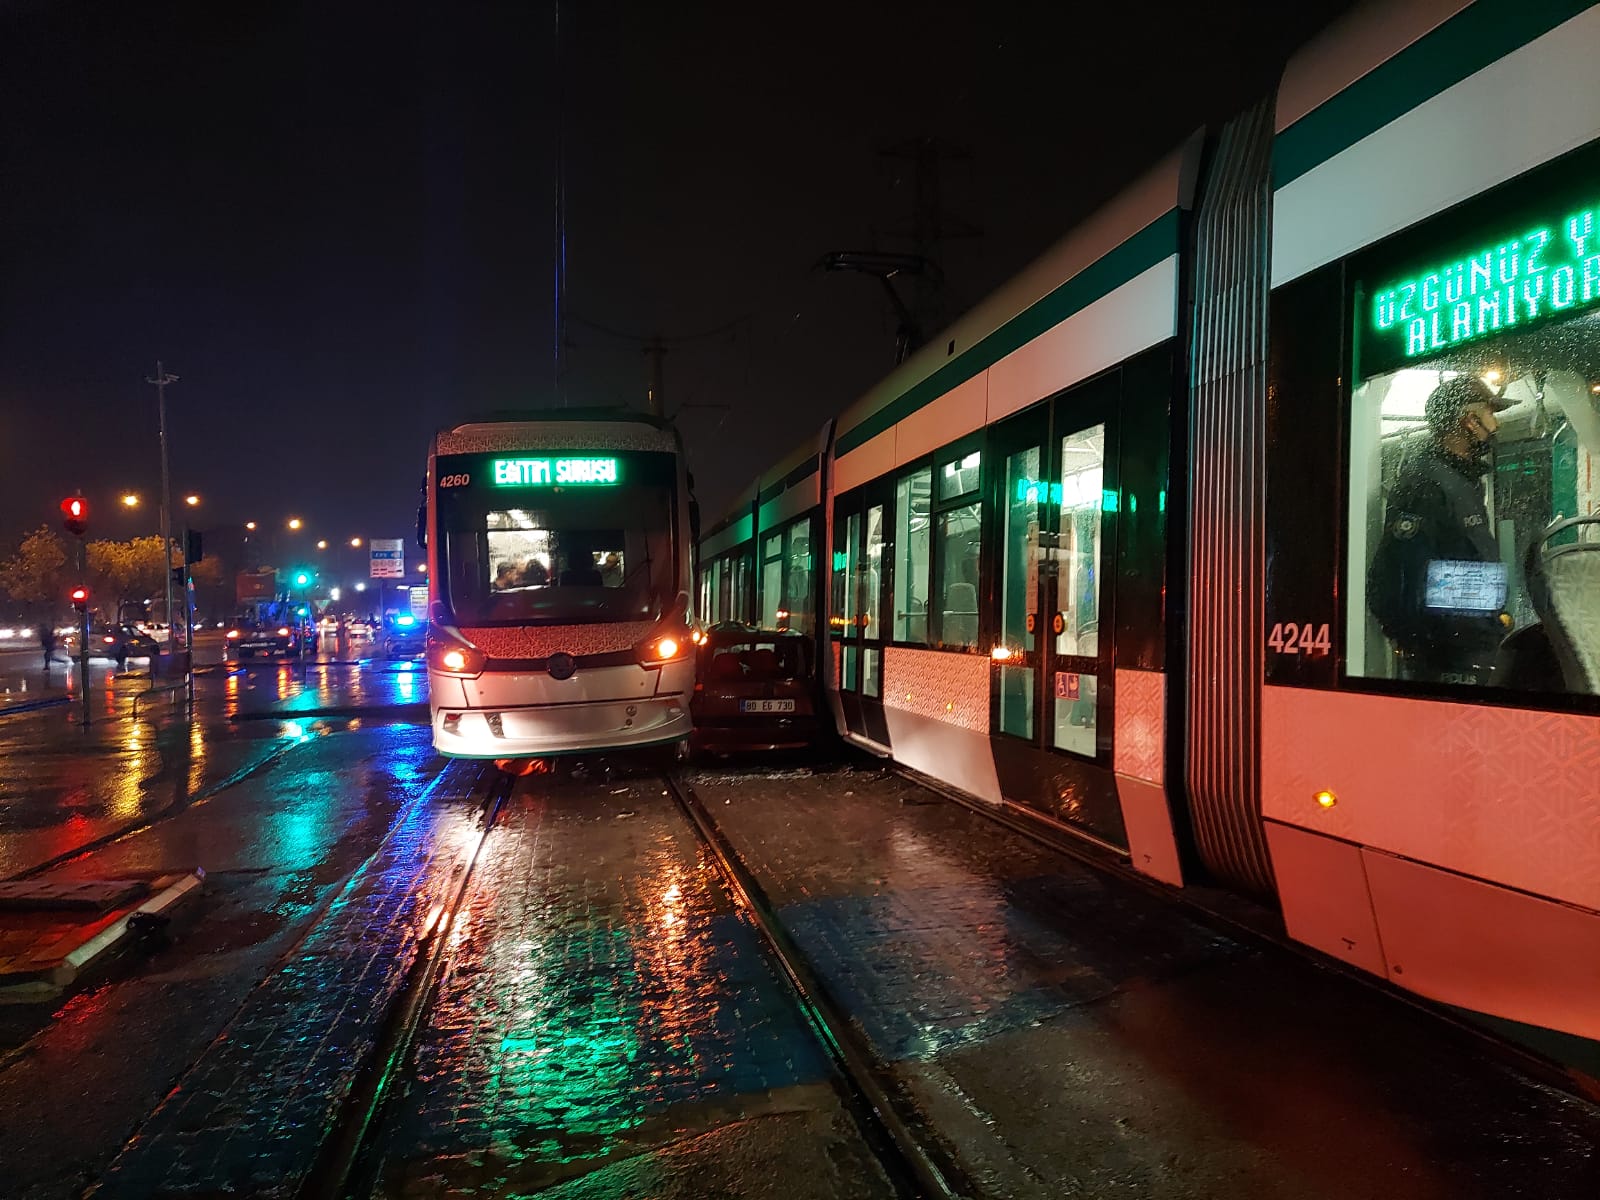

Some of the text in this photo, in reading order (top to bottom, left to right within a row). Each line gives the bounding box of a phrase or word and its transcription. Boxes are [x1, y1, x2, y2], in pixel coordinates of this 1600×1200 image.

[1377, 211, 1600, 329] ÜZGÜNÜZ Y
[440, 473, 470, 488] 4260
[1266, 622, 1332, 656] 4244
